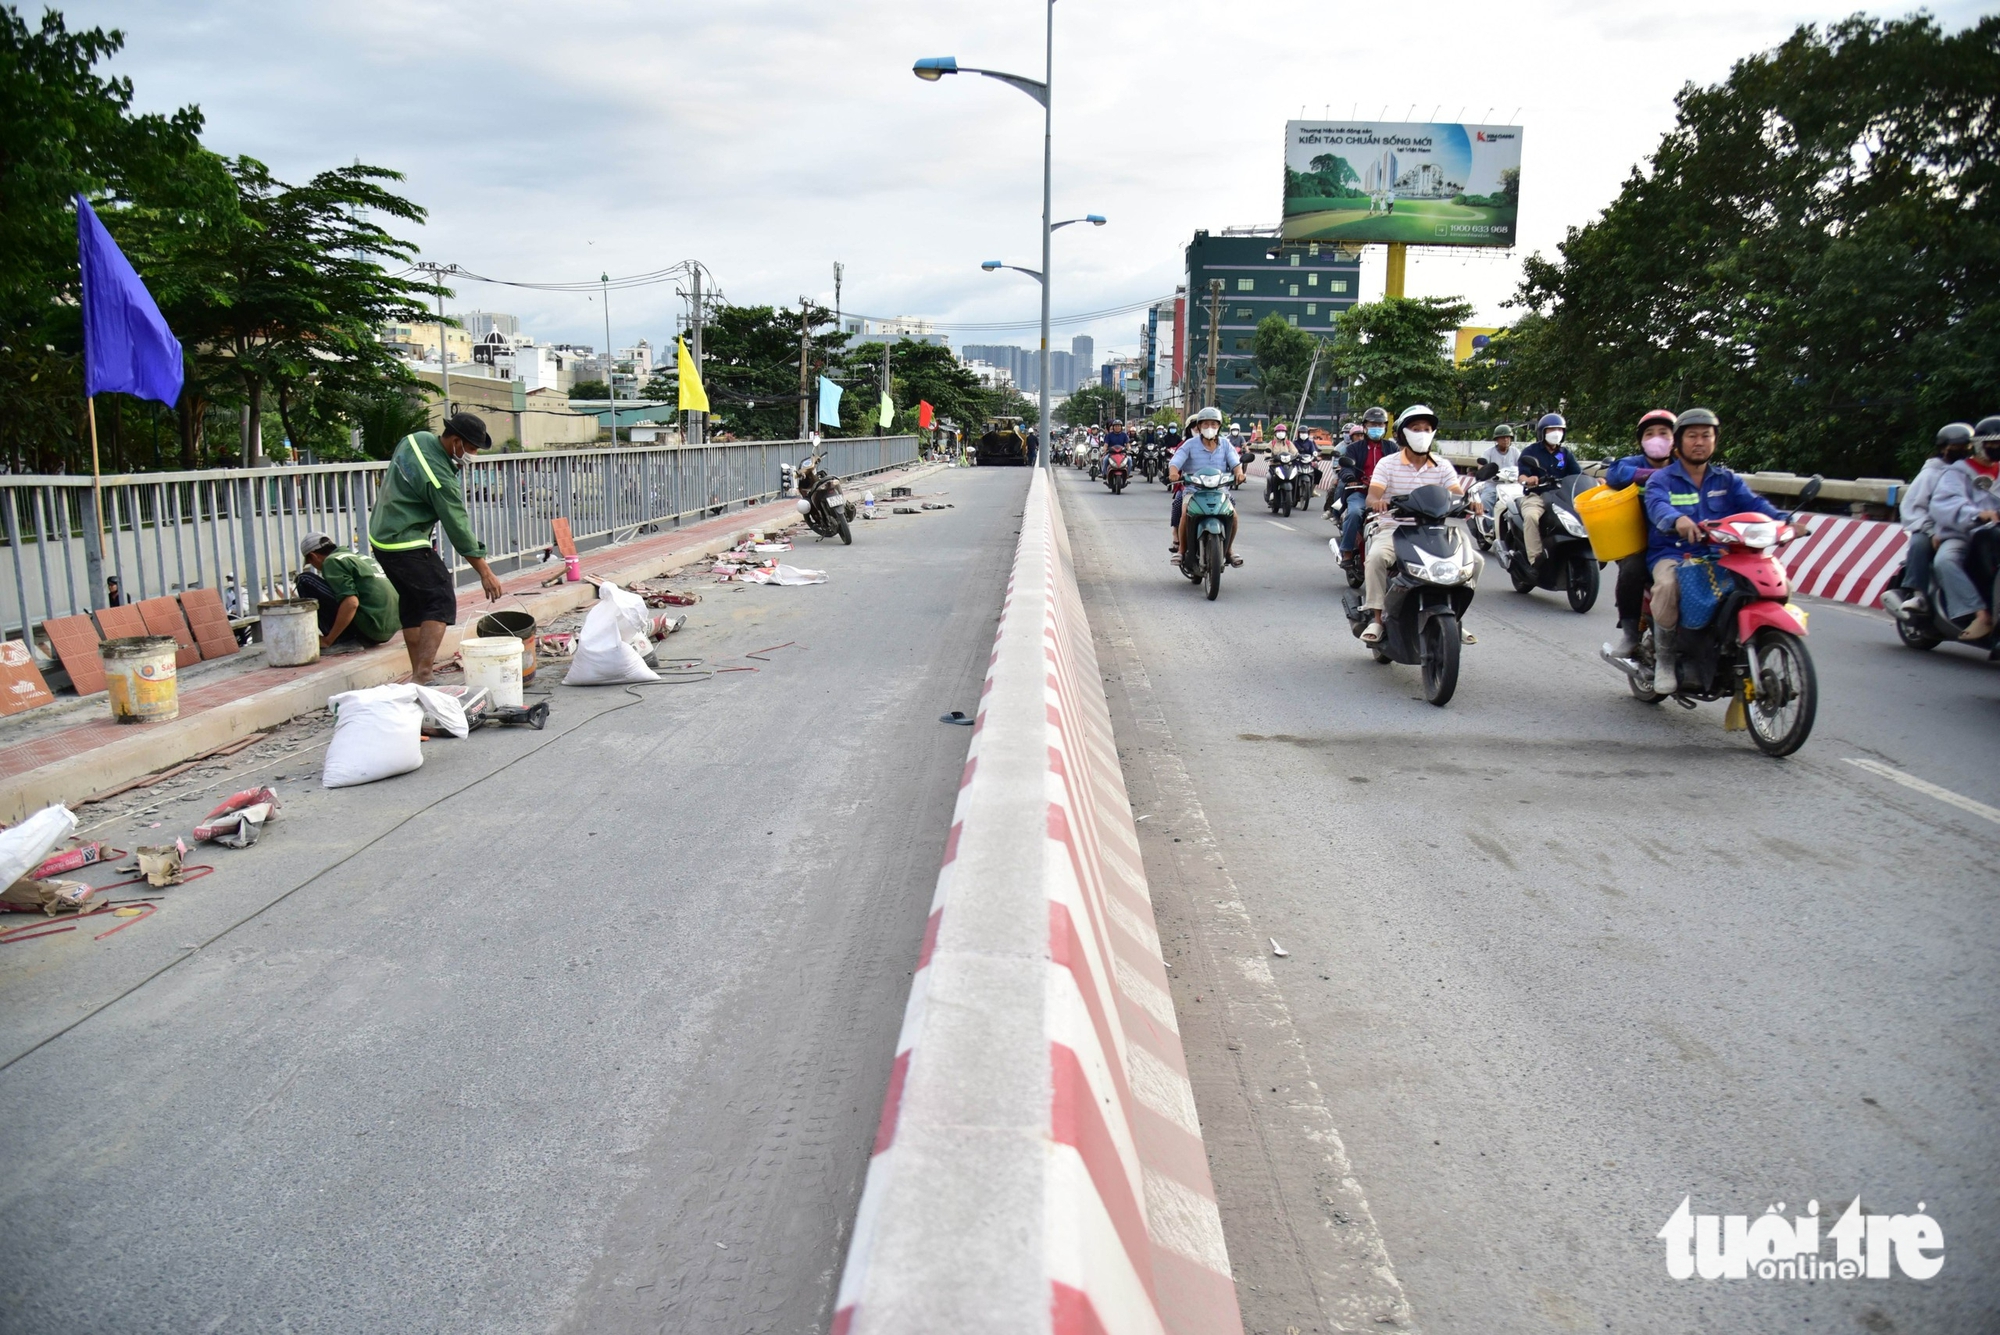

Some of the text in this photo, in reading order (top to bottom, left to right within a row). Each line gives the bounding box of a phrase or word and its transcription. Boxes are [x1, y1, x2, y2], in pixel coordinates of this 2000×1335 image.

[1299, 134, 1432, 146] KIẾN TẠO CHUẨN SỐNG MỚI
[1472, 225, 1489, 233] 633
